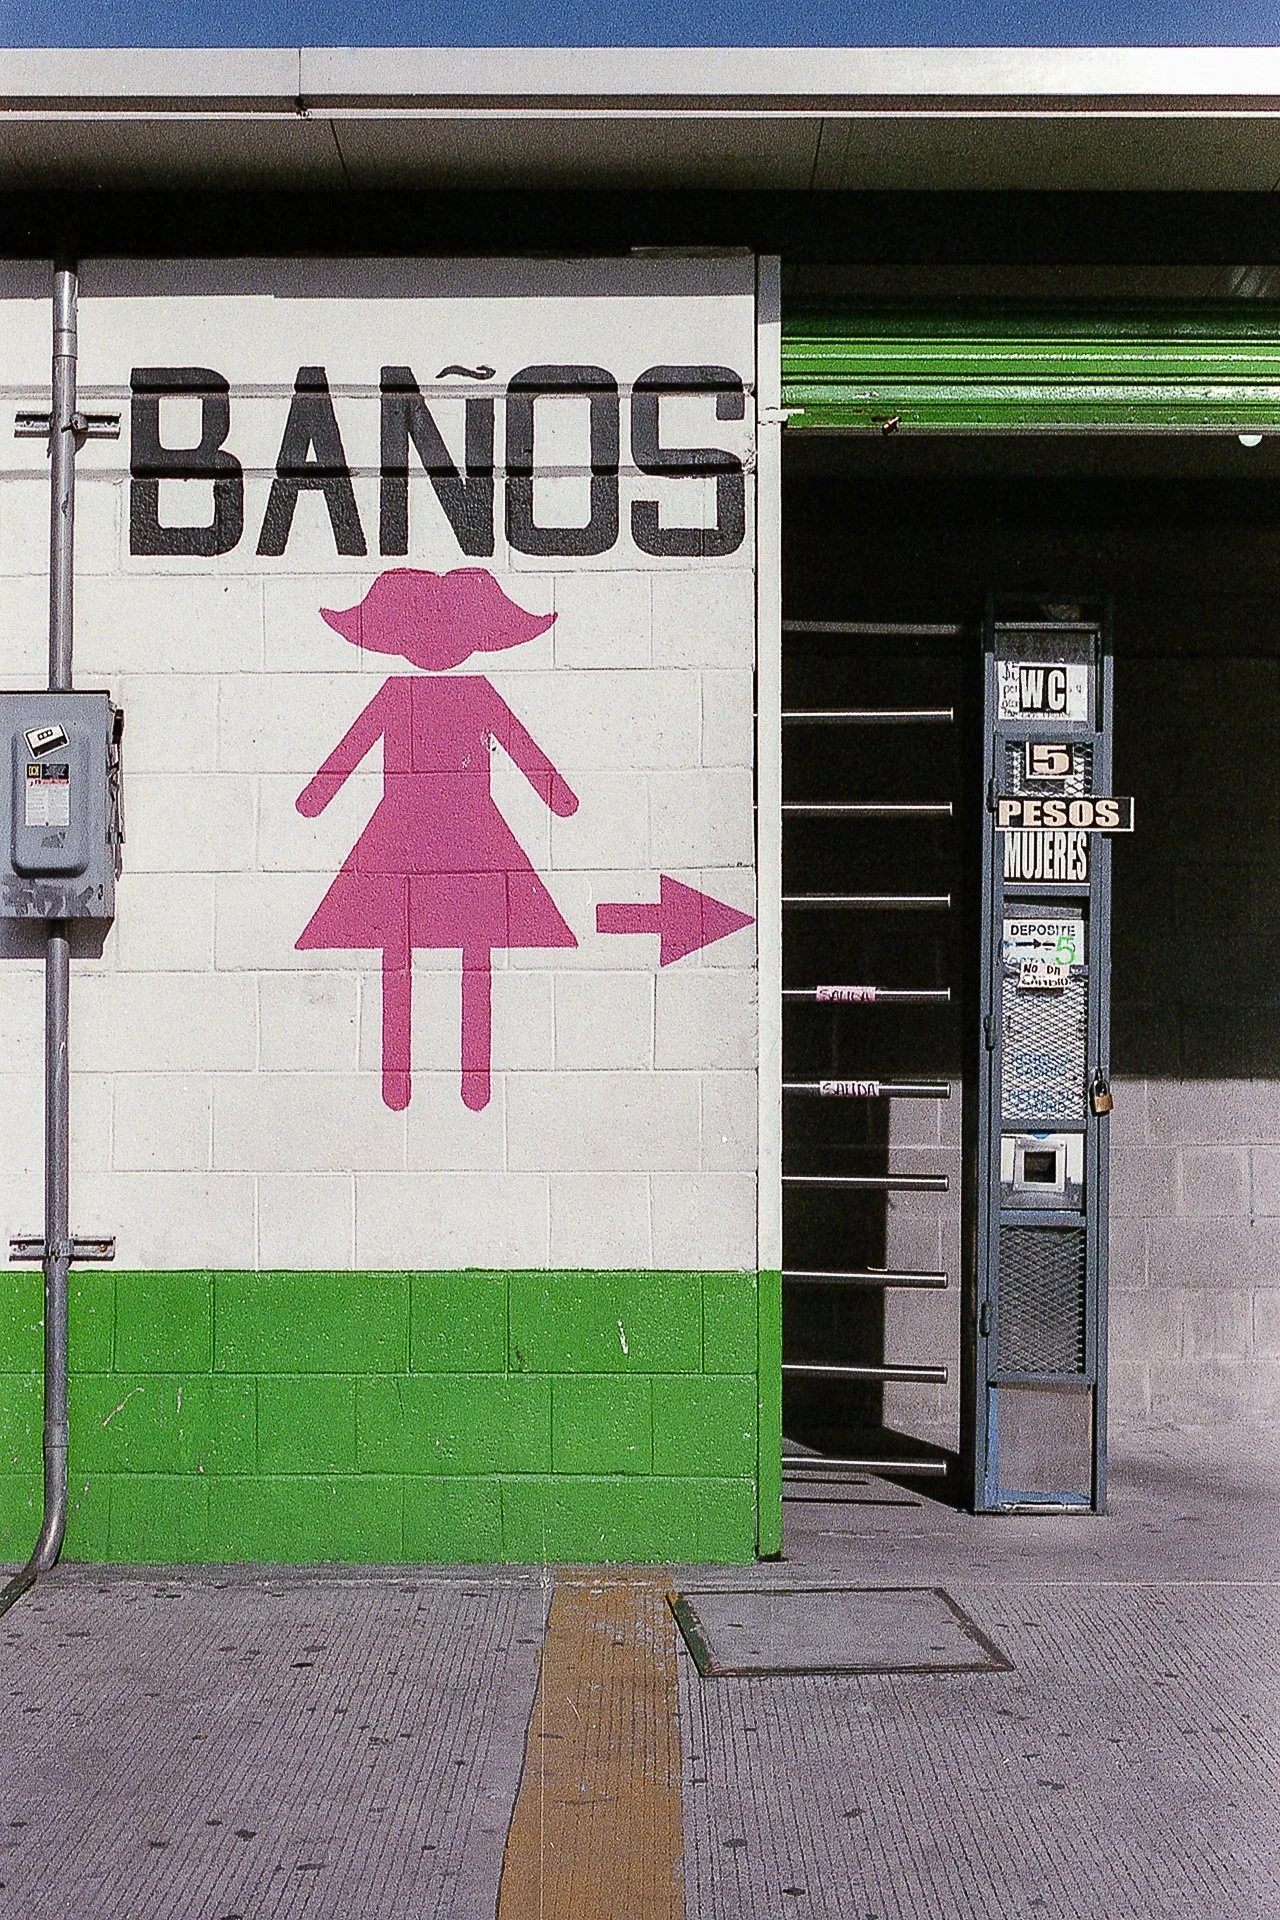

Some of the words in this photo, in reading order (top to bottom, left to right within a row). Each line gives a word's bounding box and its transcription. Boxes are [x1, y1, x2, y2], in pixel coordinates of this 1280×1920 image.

[130, 364, 746, 557] BAÑOS
[1020, 669, 1065, 710] WC
[1032, 744, 1070, 775] 5
[998, 800, 1120, 827] PESOS
[1004, 831, 1087, 880] MUJERES
[1010, 924, 1076, 937] DEPOSITE
[1056, 936, 1075, 965] 5
[1023, 963, 1038, 974] NO
